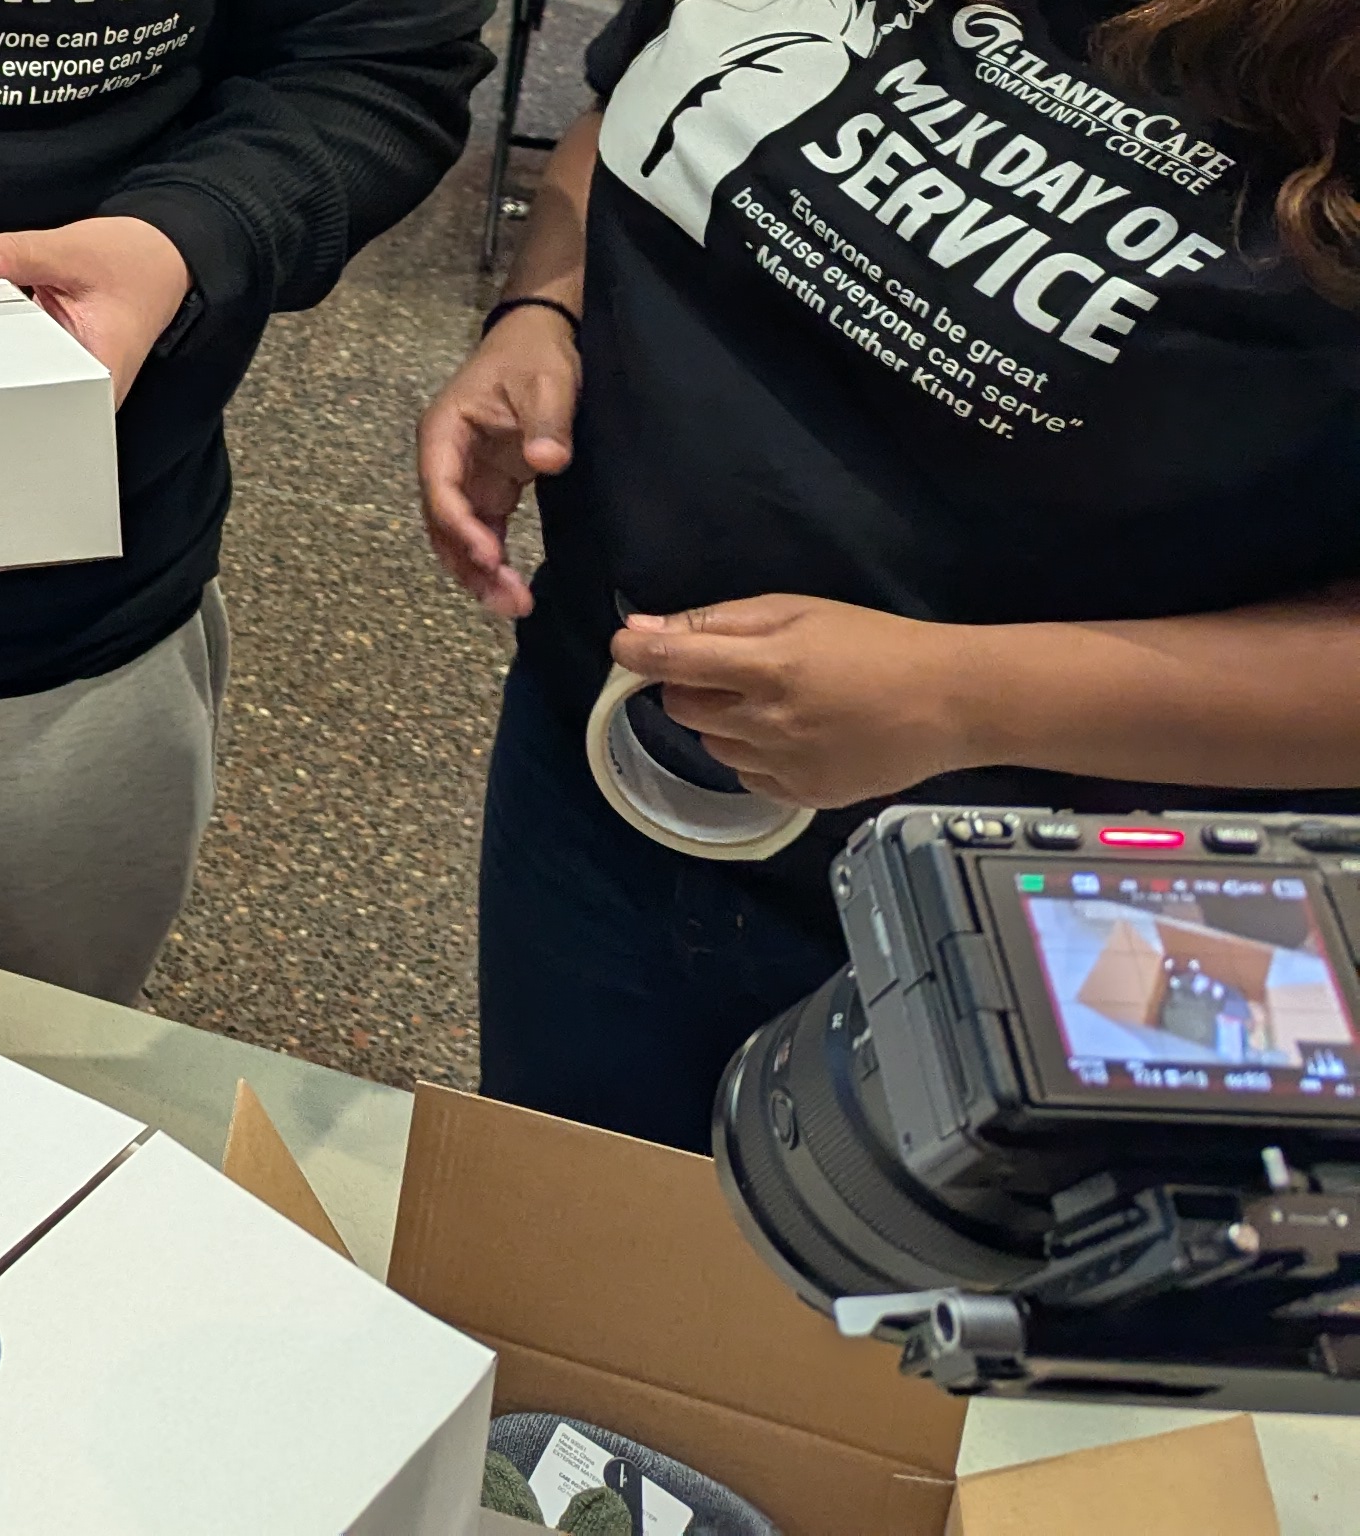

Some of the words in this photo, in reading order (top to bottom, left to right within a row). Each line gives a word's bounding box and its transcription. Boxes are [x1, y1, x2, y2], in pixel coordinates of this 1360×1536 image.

[1, 55, 105, 82] everyone
[108, 50, 142, 71] can
[28, 83, 99, 106] Luther
[98, 73, 142, 94] King
[56, 31, 99, 48] can
[103, 25, 129, 45] be
[132, 12, 181, 46] great
[874, 57, 1008, 170] MLK
[979, 132, 1132, 227] DAY
[1106, 206, 1227, 281] OF
[974, 62, 1108, 138] COMMUNITY
[1104, 134, 1213, 197] COLLEGE
[730, 186, 826, 269] because
[822, 264, 928, 352] everyone
[927, 346, 978, 389] can
[800, 111, 1160, 365] SERVICE
[755, 243, 828, 315] Martin
[828, 303, 910, 373] Luther
[910, 365, 976, 418] King
[978, 413, 1015, 440] Jr.
[885, 278, 931, 319] can
[933, 306, 968, 344] be
[967, 338, 1050, 394] great
